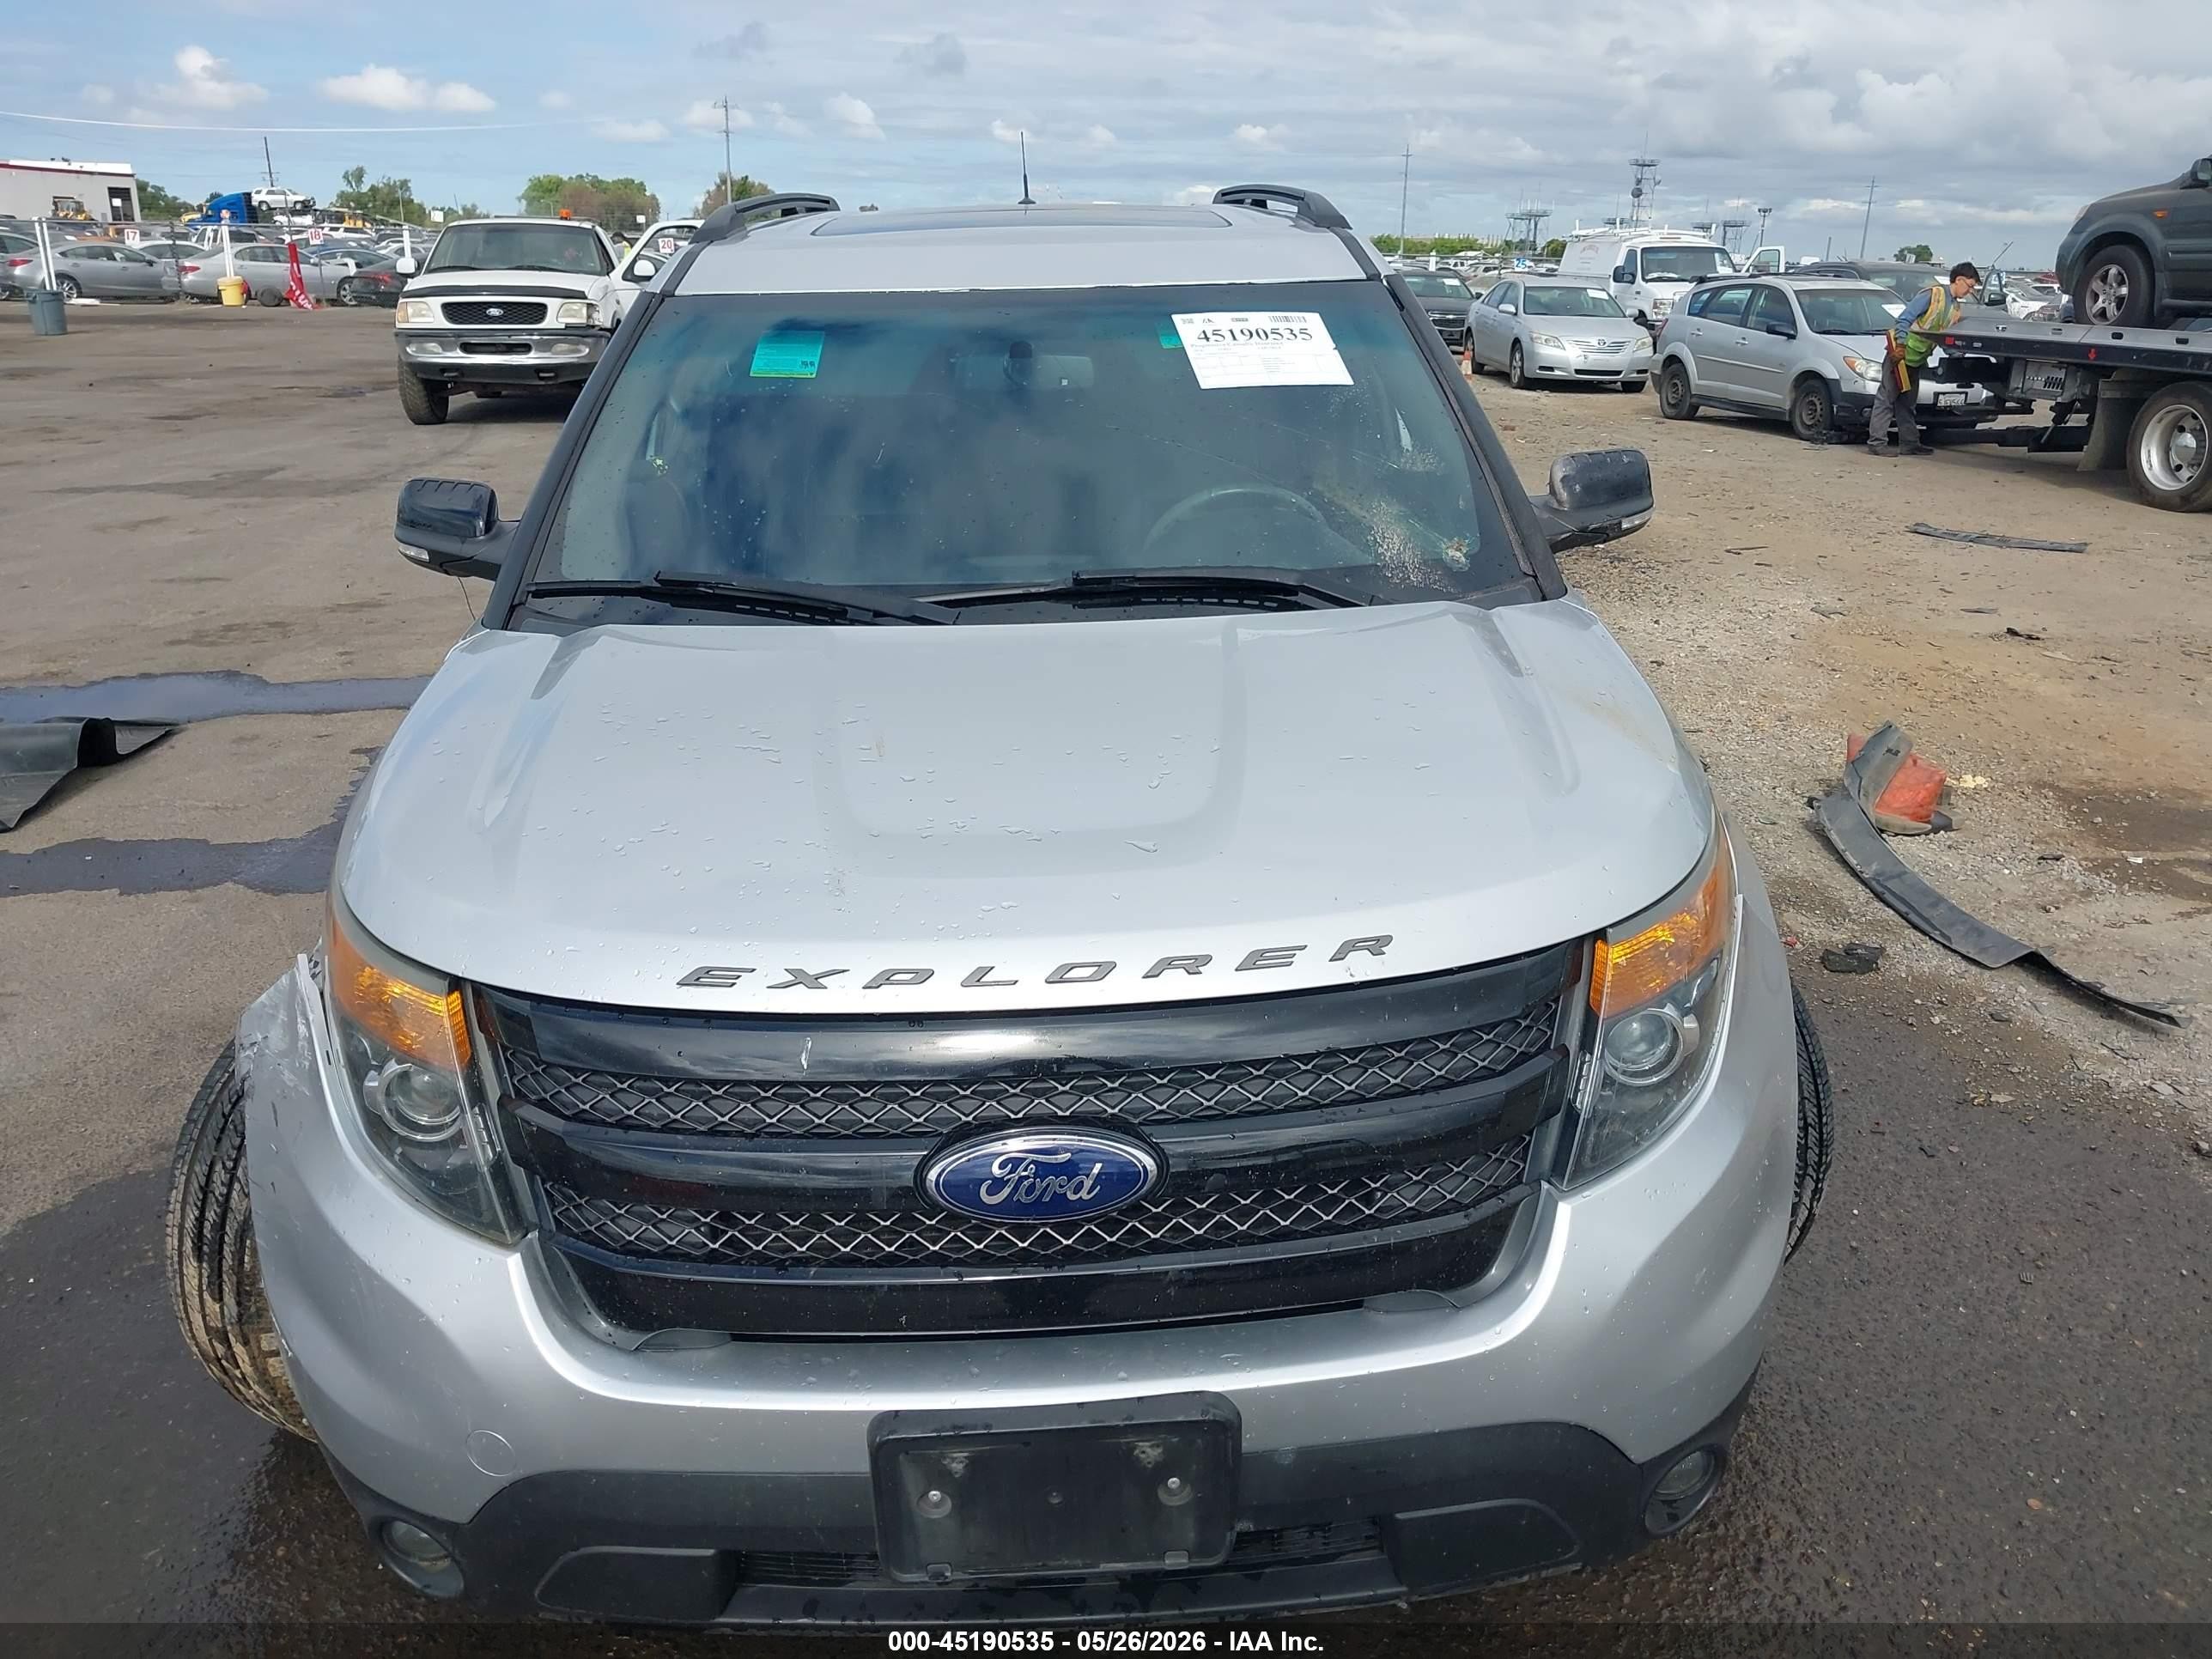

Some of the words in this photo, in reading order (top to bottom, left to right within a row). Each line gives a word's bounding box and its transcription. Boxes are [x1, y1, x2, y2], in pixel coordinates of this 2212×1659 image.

[126, 231, 137, 241] 17
[310, 230, 321, 241] 18
[661, 240, 672, 249] 20
[1515, 258, 1528, 269] 25
[1197, 327, 1313, 343] 45190535
[676, 933, 1395, 990] EXPLORER
[979, 1151, 1103, 1206] Ford
